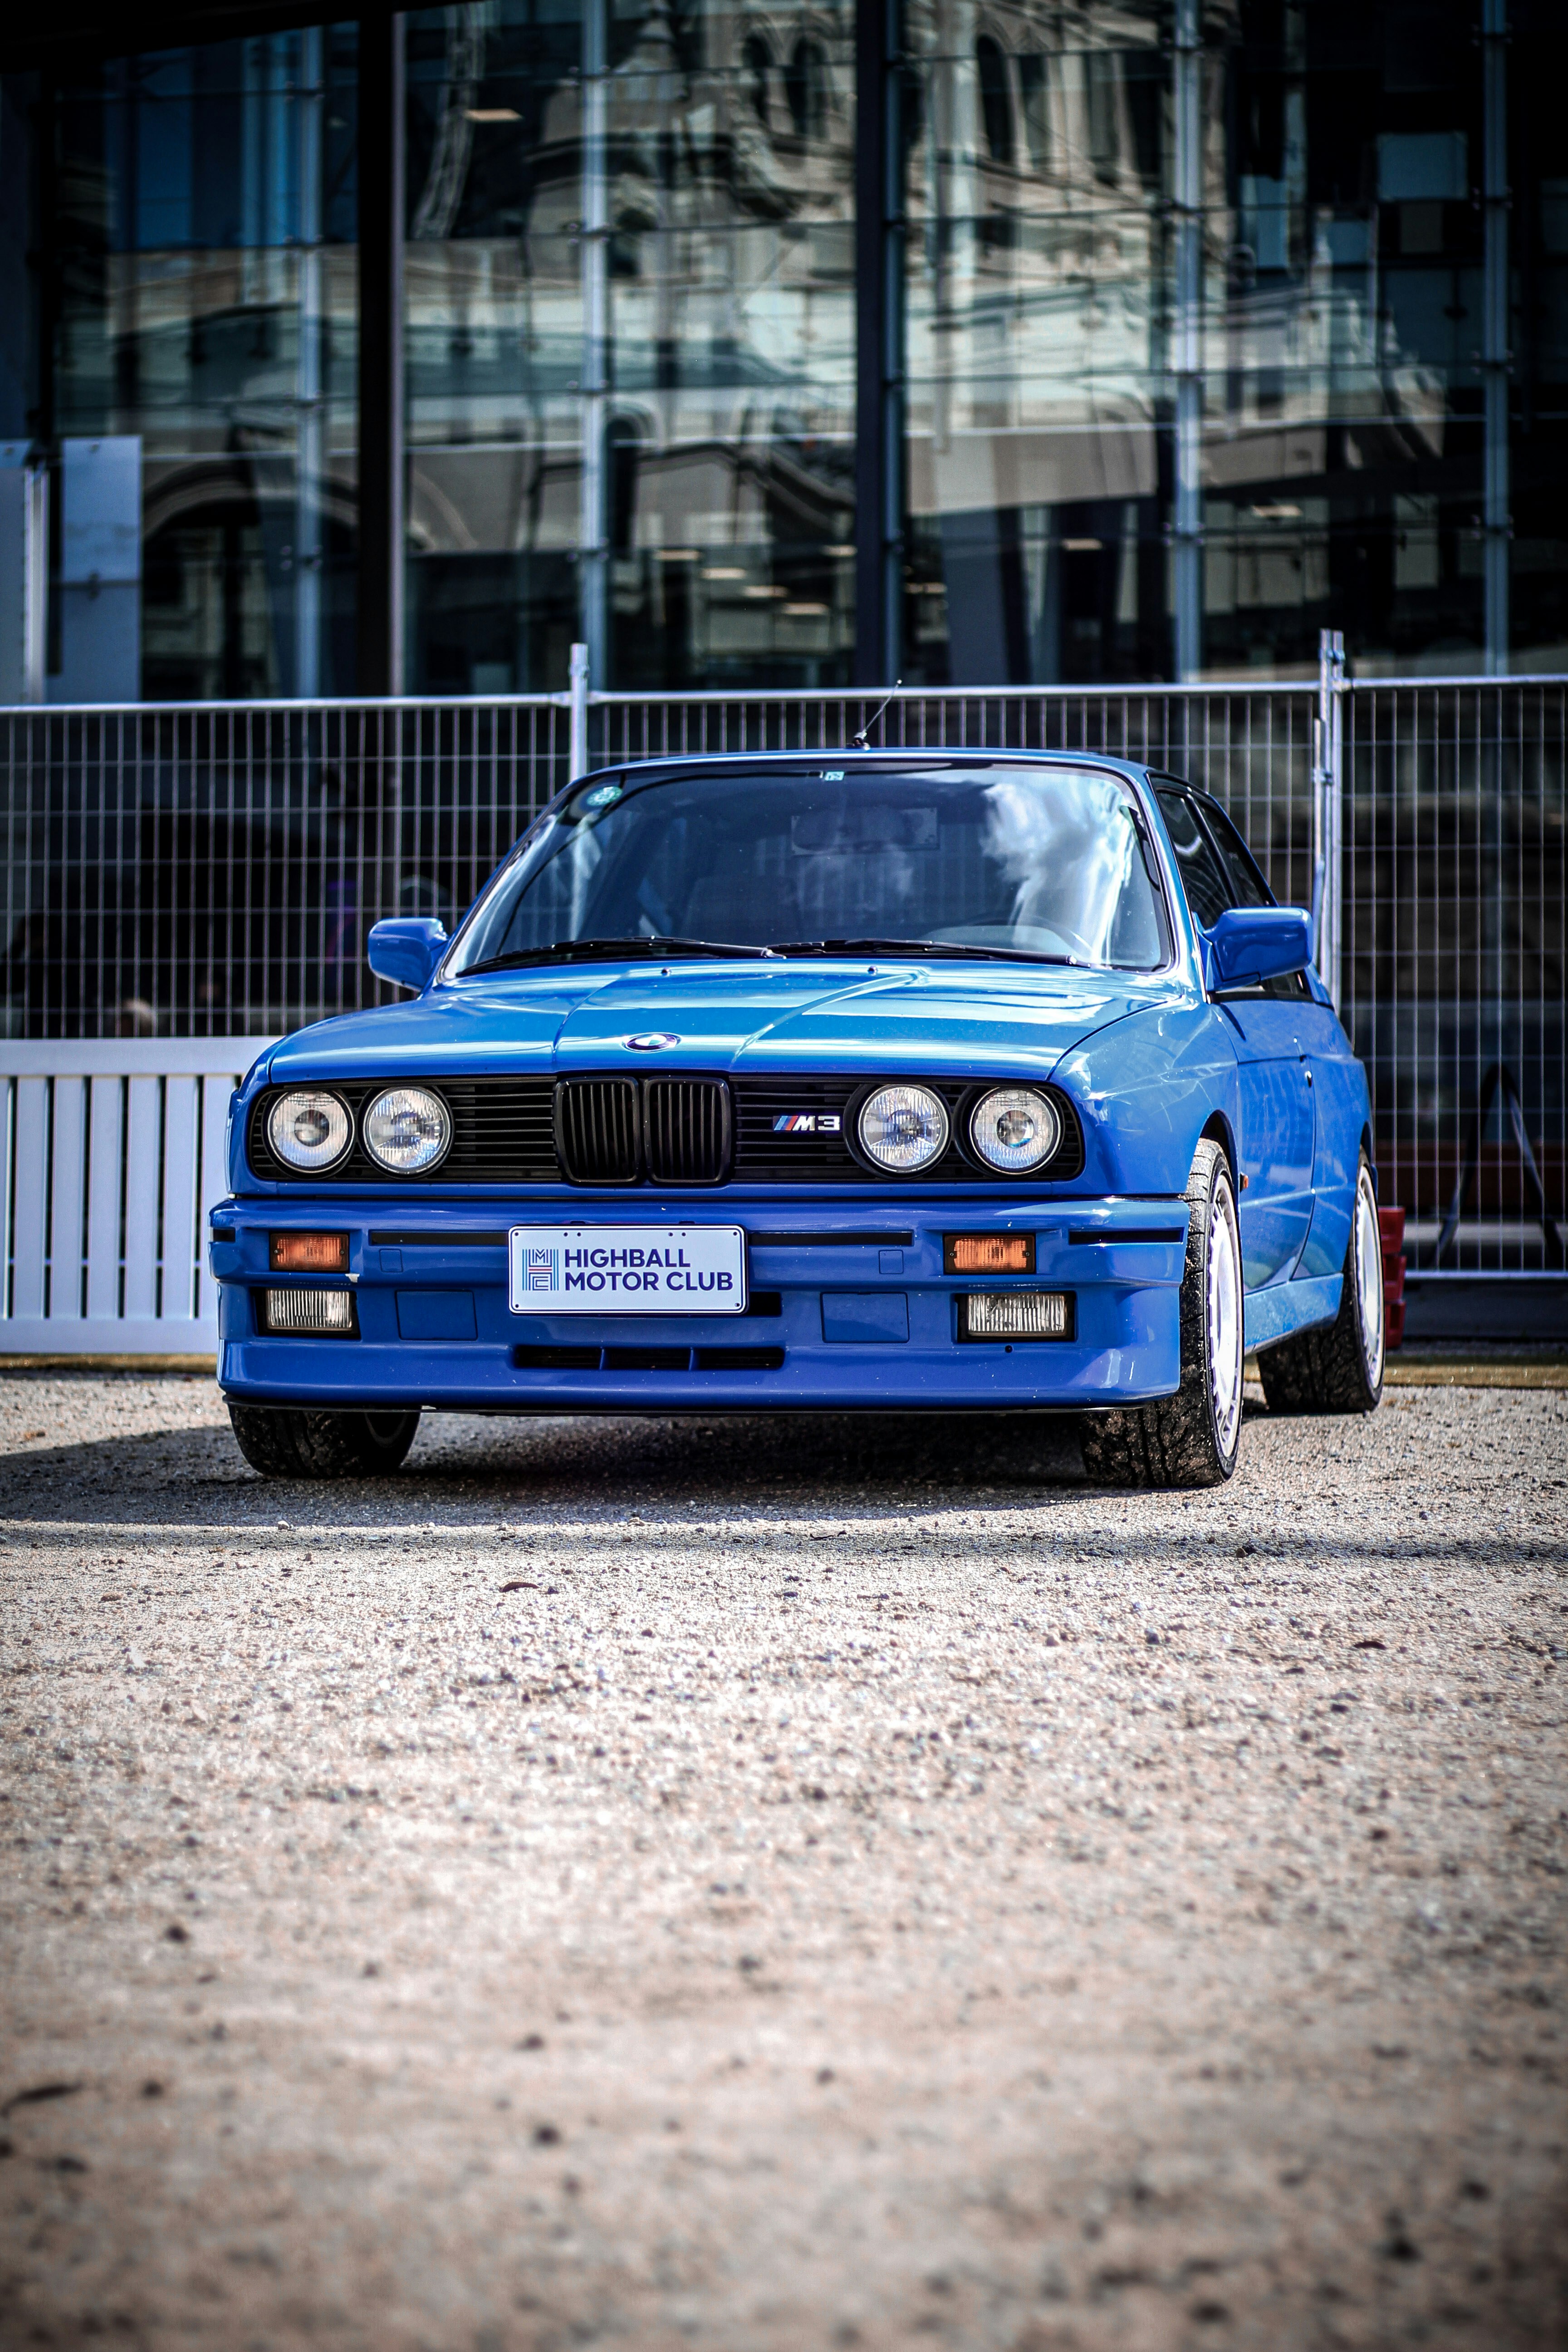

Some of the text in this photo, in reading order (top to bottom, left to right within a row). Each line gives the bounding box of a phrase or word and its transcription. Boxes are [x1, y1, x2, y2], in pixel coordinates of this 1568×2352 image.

[792, 1115, 840, 1131] M3
[565, 1249, 691, 1268] HIGHBALL
[565, 1272, 733, 1291] MOTOR CLUB
